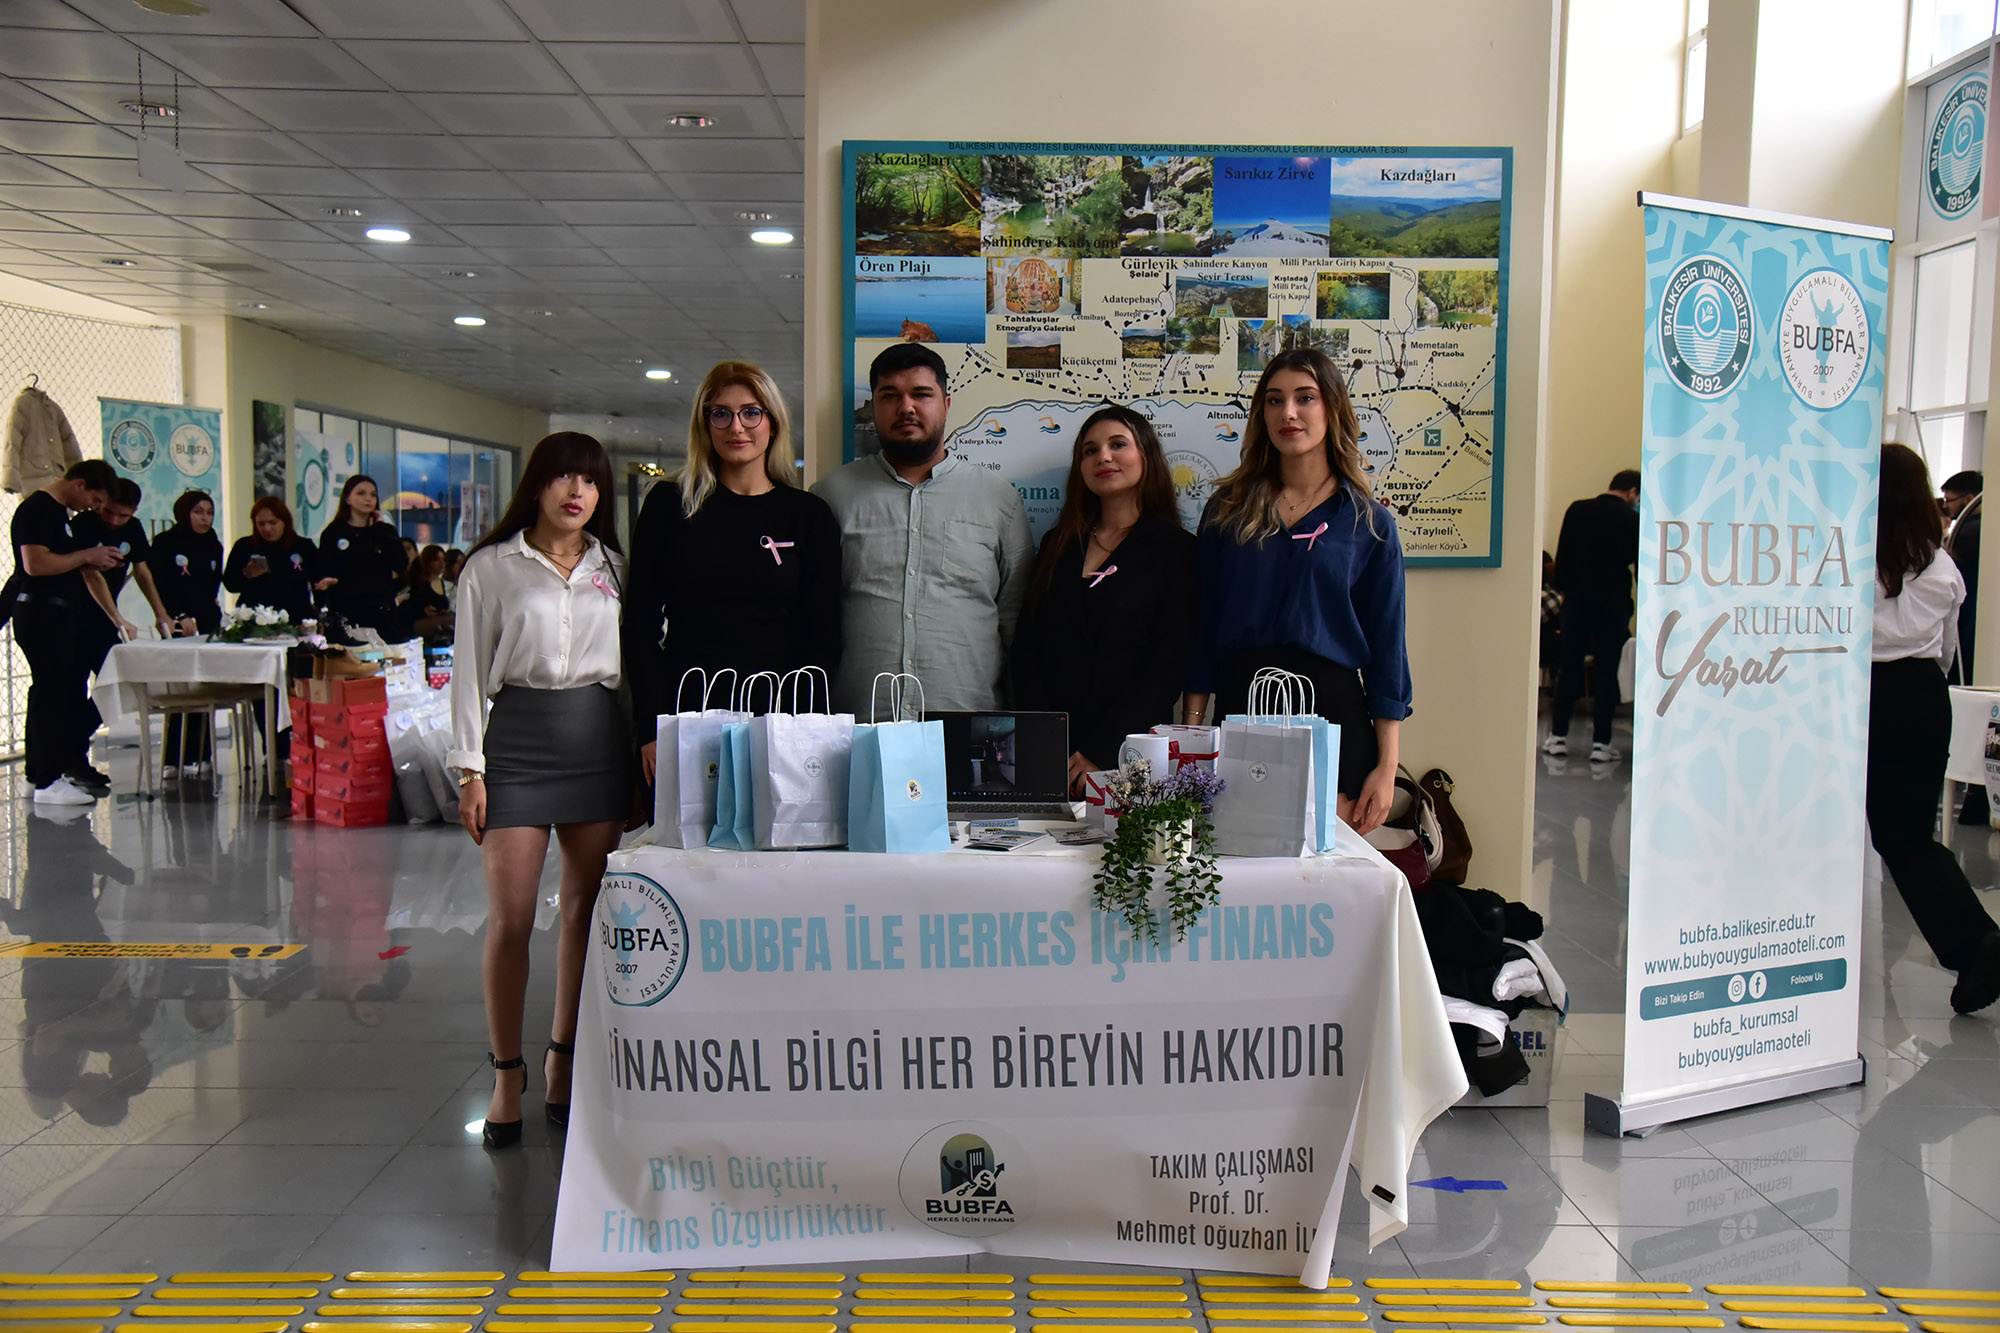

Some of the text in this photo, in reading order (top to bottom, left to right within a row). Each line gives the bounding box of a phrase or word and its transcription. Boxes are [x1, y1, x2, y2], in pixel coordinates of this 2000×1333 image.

[1224, 167, 1315, 181] Sarıkız Zirve
[1380, 168, 1456, 184] Kazdağları
[1947, 189, 1972, 210] 1992
[982, 235, 1052, 250] Şahindere
[859, 256, 932, 274] Ören Plajı
[1121, 258, 1178, 273] Gürleyik
[1182, 259, 1268, 271] Şahindere Kanyon
[1279, 258, 1386, 269] Milli Parklar Giriş Kapısı
[1197, 272, 1253, 282] Seyir Terası
[1101, 295, 1158, 305] Adatepebaşı
[1268, 292, 1287, 301] Giriş
[1664, 261, 1750, 345] BALIKESİR ÜNİVERSİTESİ
[1786, 276, 1837, 323] UYGULAMALI
[1840, 283, 1865, 338] BİLİMLER
[1004, 315, 1060, 324] Tahtakuşlar
[1441, 321, 1474, 333] Akyer
[996, 324, 1042, 333] Etnografya
[1410, 341, 1459, 349] Memetalan
[1792, 324, 1857, 355] BUBFA
[1351, 347, 1372, 355] Güre
[1431, 350, 1465, 358] Ortaoba
[1062, 356, 1117, 368] Küçükçetmi
[1018, 369, 1061, 380] Yeşilyurt
[1813, 365, 1835, 376] 2007
[1690, 374, 1723, 393] 1992
[1207, 411, 1250, 420] Altınoluk
[1460, 408, 1494, 417] Edremit
[175, 443, 209, 456] BUBFA
[1387, 482, 1424, 491] BUBYO
[1411, 506, 1463, 515] Burhaniye
[1405, 542, 1438, 552] Şahinler
[1653, 520, 1854, 587] BUBFA
[1732, 606, 1854, 635] RUHUNU
[1655, 609, 1848, 717] Yaşat
[638, 884, 679, 935] BİLİMLER
[601, 921, 669, 952] BUBFA
[1679, 912, 1816, 946] bubfa.balikesir.edu.tr
[699, 895, 1335, 983] BUBFA İLE HERKES İÇİN FİNANS
[1644, 933, 1846, 976] www.bubyouygulamaoteli.com
[615, 962, 639, 974] 2007
[1655, 996, 1668, 1007] Bizi
[1669, 992, 1688, 1005] Takip
[1689, 990, 1705, 1001] Edin
[1814, 972, 1824, 982] Us
[1693, 1005, 1799, 1040] bubfa_kurumsal
[787, 1029, 883, 1092] BİLGİ
[901, 1036, 973, 1090] HER
[992, 1024, 1144, 1089] BİREYİN
[1163, 1022, 1344, 1085] HAKKIDIR
[1678, 1029, 1812, 1070] bubyouygulamaoteli
[1150, 1147, 1314, 1185] TAKIM ÇALIŞMASI
[648, 1155, 840, 1198] Bilgi Güçtür,
[925, 1199, 1014, 1215] BUBFA
[1189, 1189, 1269, 1215] Prof. Dr.
[602, 1202, 896, 1254] Finans Özgürlüktür.
[1117, 1219, 1196, 1246] Mehmet
[1204, 1224, 1287, 1252] Oğuzhan
